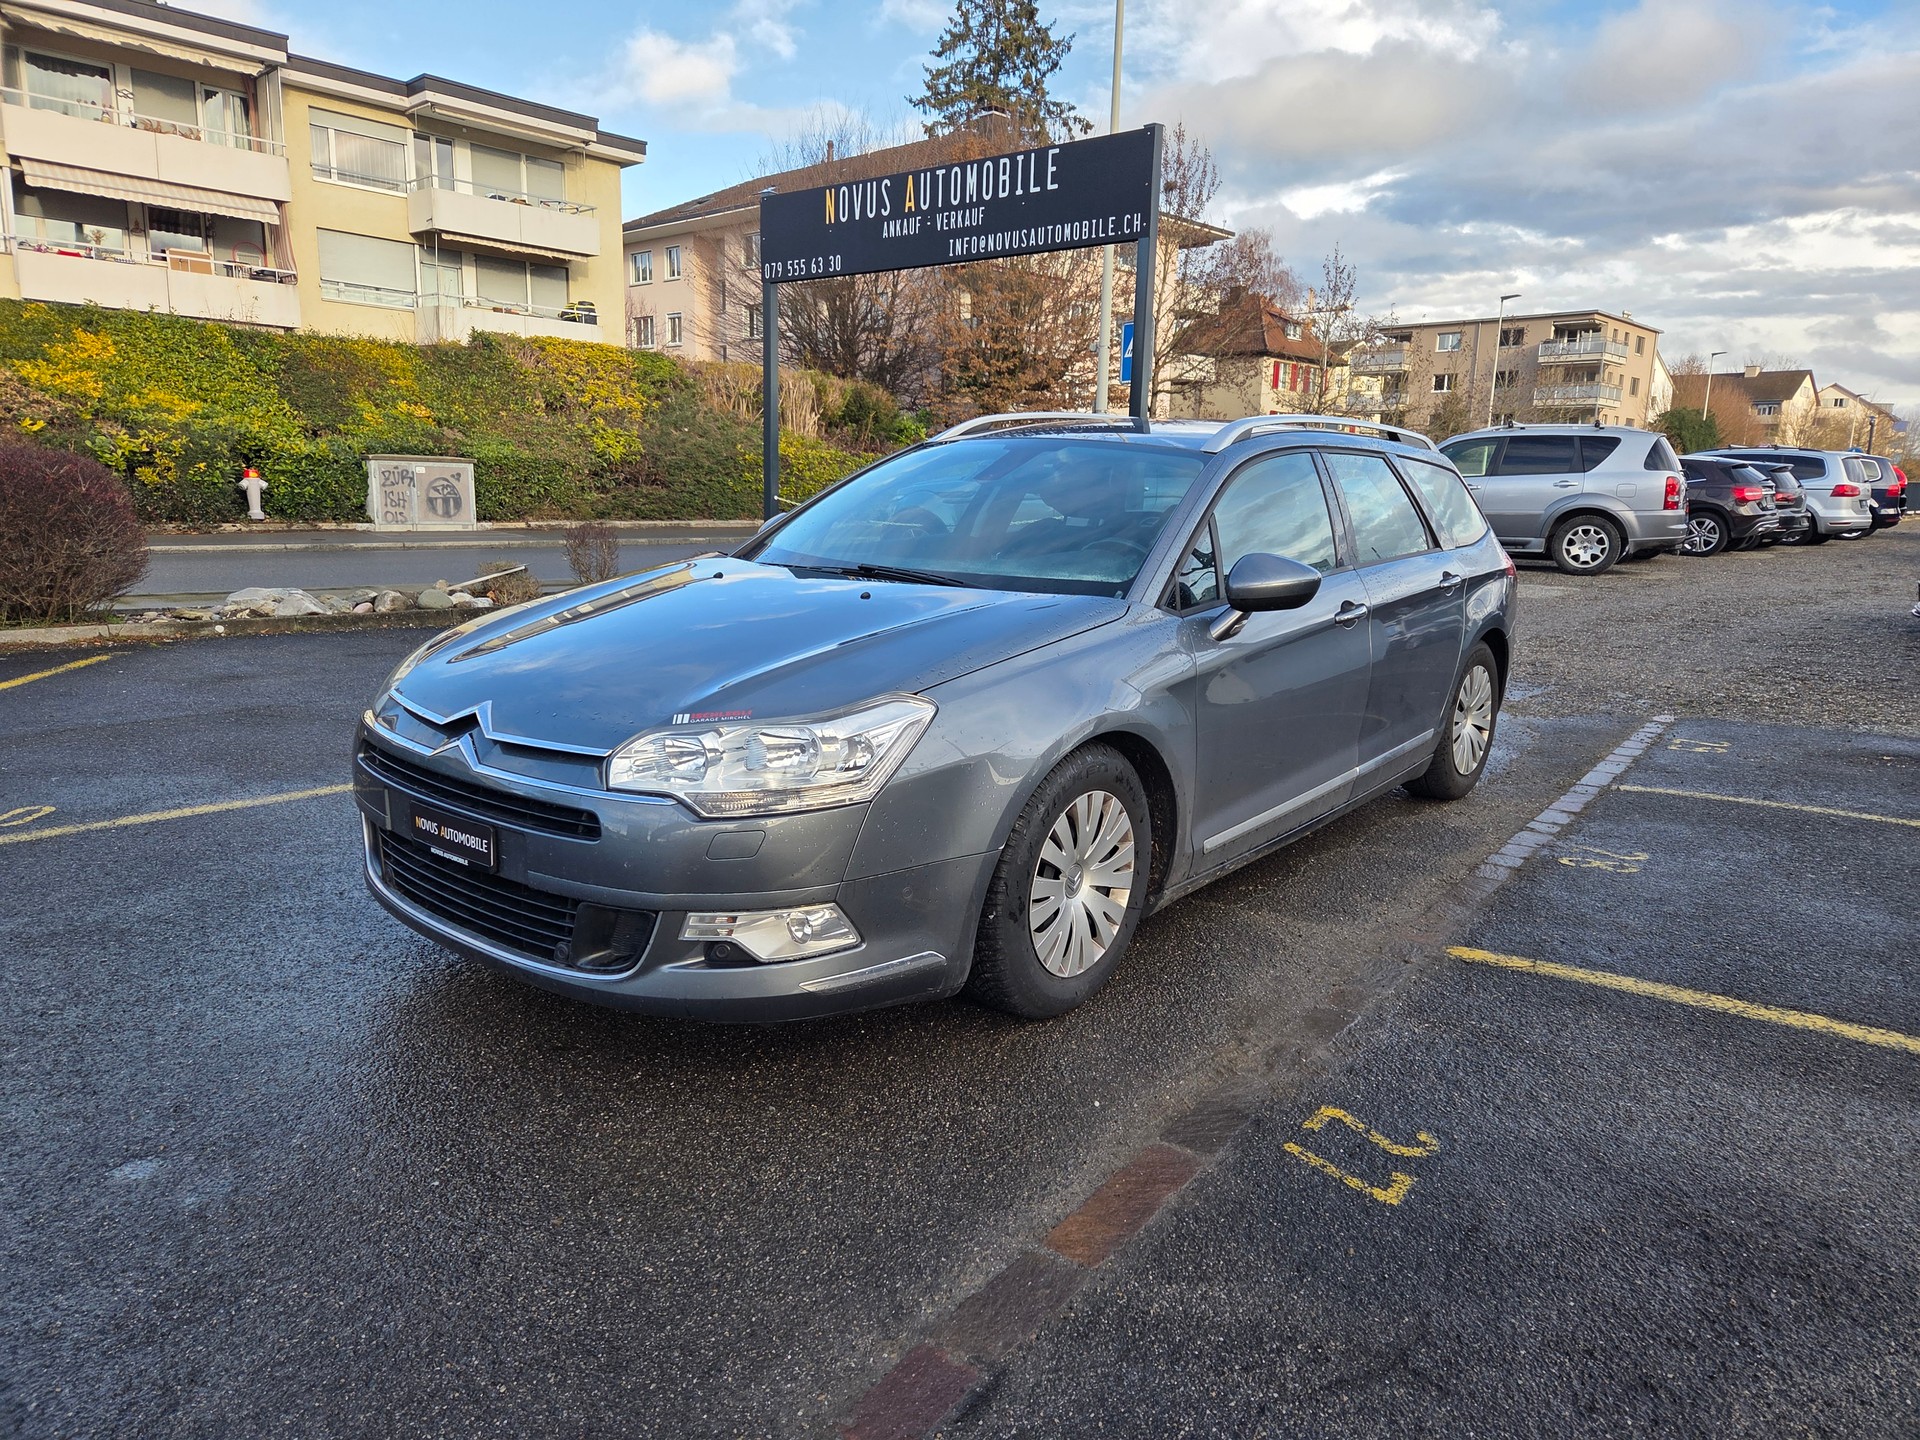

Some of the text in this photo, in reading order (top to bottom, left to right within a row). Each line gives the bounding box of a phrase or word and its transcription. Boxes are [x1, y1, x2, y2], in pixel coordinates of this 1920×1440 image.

[825, 148, 1060, 225] NOVUS AUTOMOBILE
[882, 219, 922, 239] ANKAUF
[936, 207, 985, 231] VERKAUF
[948, 213, 1142, 257] INFO@NOVUSAUTOMOBILE.CH
[764, 255, 842, 280] 079 555 63 30
[415, 816, 488, 853] NOVUS AUTOMOBILE
